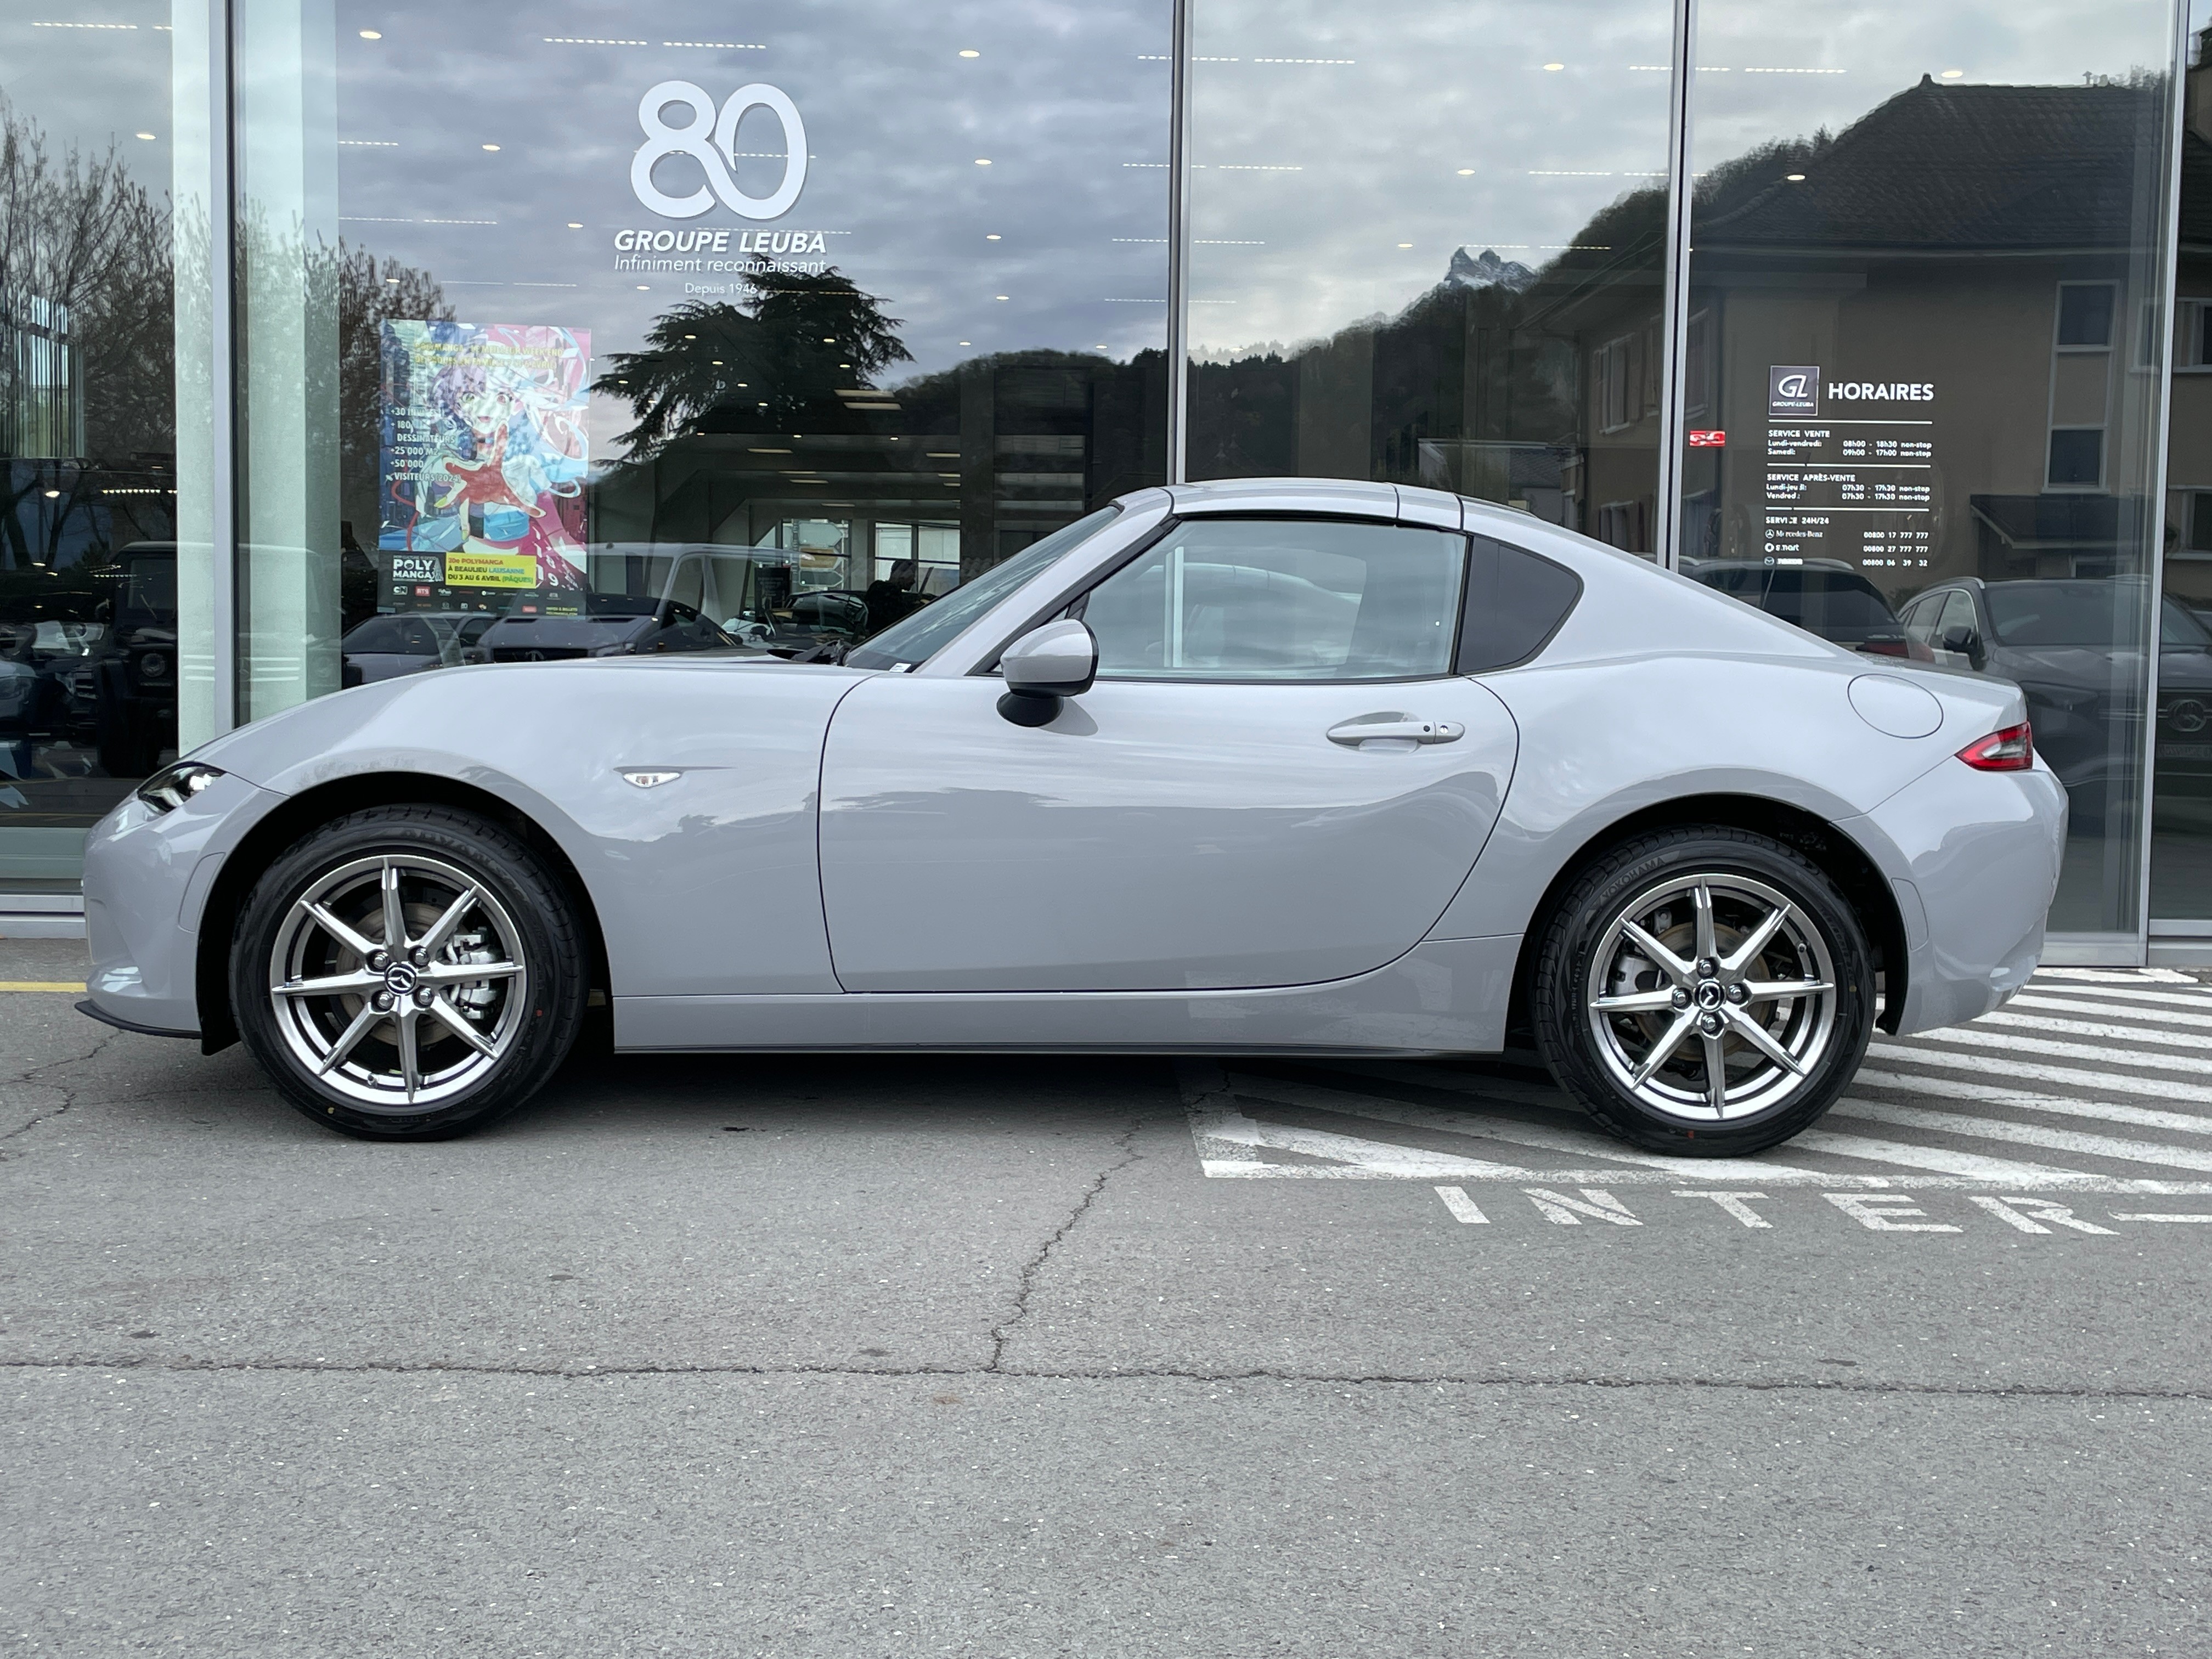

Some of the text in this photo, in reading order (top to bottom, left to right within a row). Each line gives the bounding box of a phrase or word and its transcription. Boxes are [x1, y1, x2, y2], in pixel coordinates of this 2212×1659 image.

[631, 80, 807, 219] 80
[615, 230, 826, 253] GROUPE LEUBA
[615, 254, 826, 273] Infiniment reconnaissant
[685, 283, 758, 296] Depuis 1946
[1829, 382, 1934, 400] HORAIRES
[397, 433, 455, 443] DESSINATEURS
[1803, 473, 1855, 482] APRÈS-VENTE
[393, 559, 432, 570] POLY
[393, 571, 432, 579] MANGA
[1601, 856, 1666, 899] YOKOHAMA
